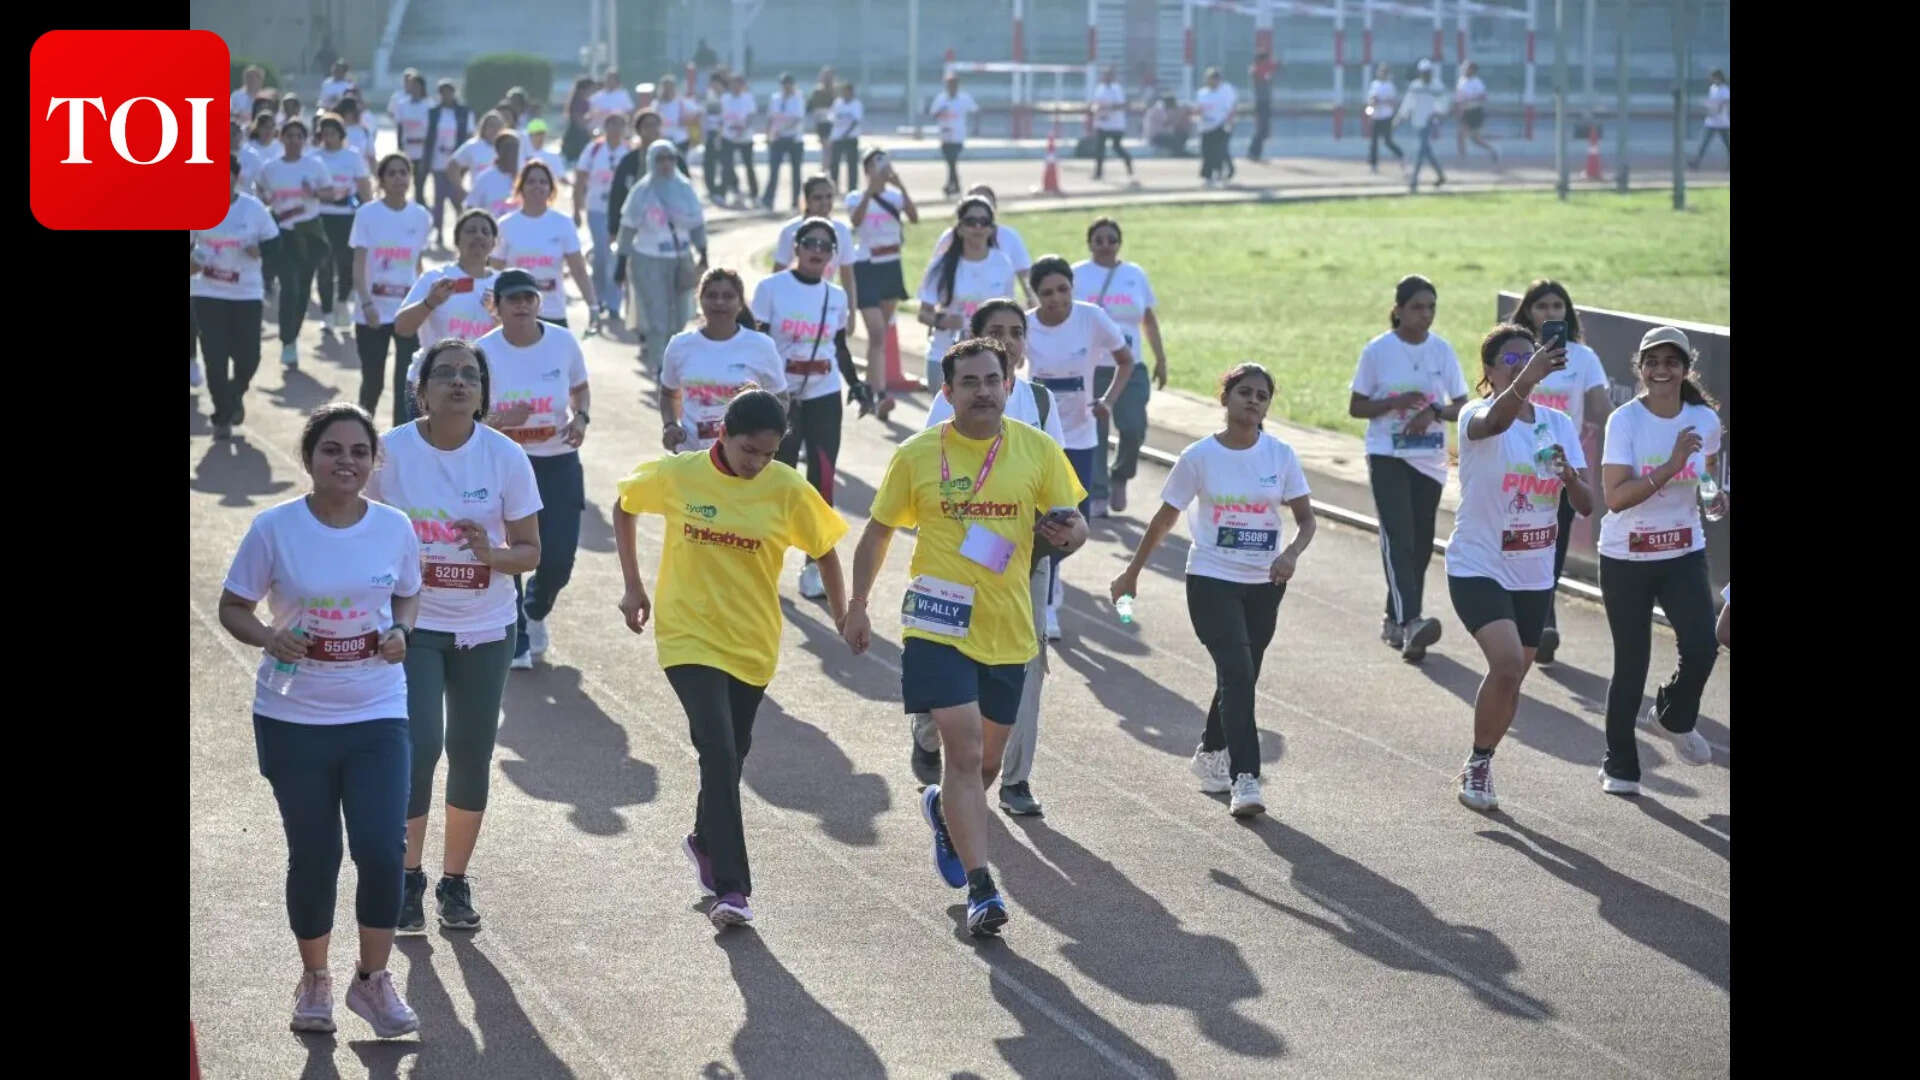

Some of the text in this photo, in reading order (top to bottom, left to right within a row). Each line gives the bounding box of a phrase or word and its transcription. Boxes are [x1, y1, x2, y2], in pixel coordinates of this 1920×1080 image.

[1502, 473, 1562, 496] PINK
[1522, 530, 1551, 544] 51181
[1648, 531, 1680, 545] 51178
[435, 566, 474, 580] 52019
[918, 598, 960, 617] VI-ALLY
[324, 638, 365, 652] 55008
